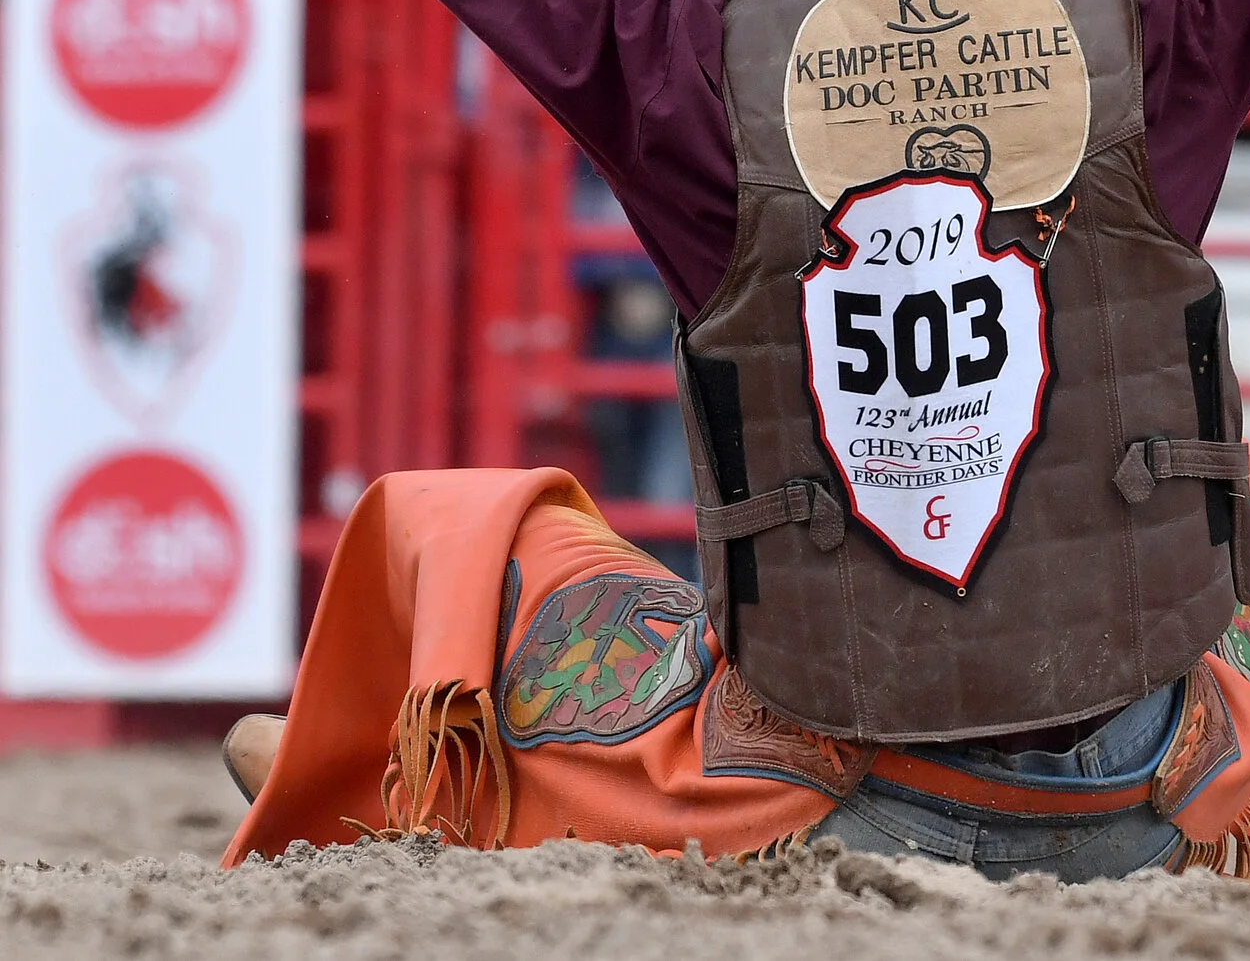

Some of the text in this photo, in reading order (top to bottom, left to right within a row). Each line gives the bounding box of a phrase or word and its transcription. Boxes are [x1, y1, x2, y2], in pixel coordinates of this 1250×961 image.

[796, 26, 1072, 84] KEMPFER CATTLE
[820, 65, 1051, 111] DOC PARTIN
[889, 102, 989, 126] RANCH
[864, 213, 965, 266] 2019
[834, 274, 1009, 398] 503
[855, 391, 993, 432] 123rd Annual
[849, 433, 1002, 463] CHEYENNE
[853, 460, 1000, 487] FRONTIER DAYS
